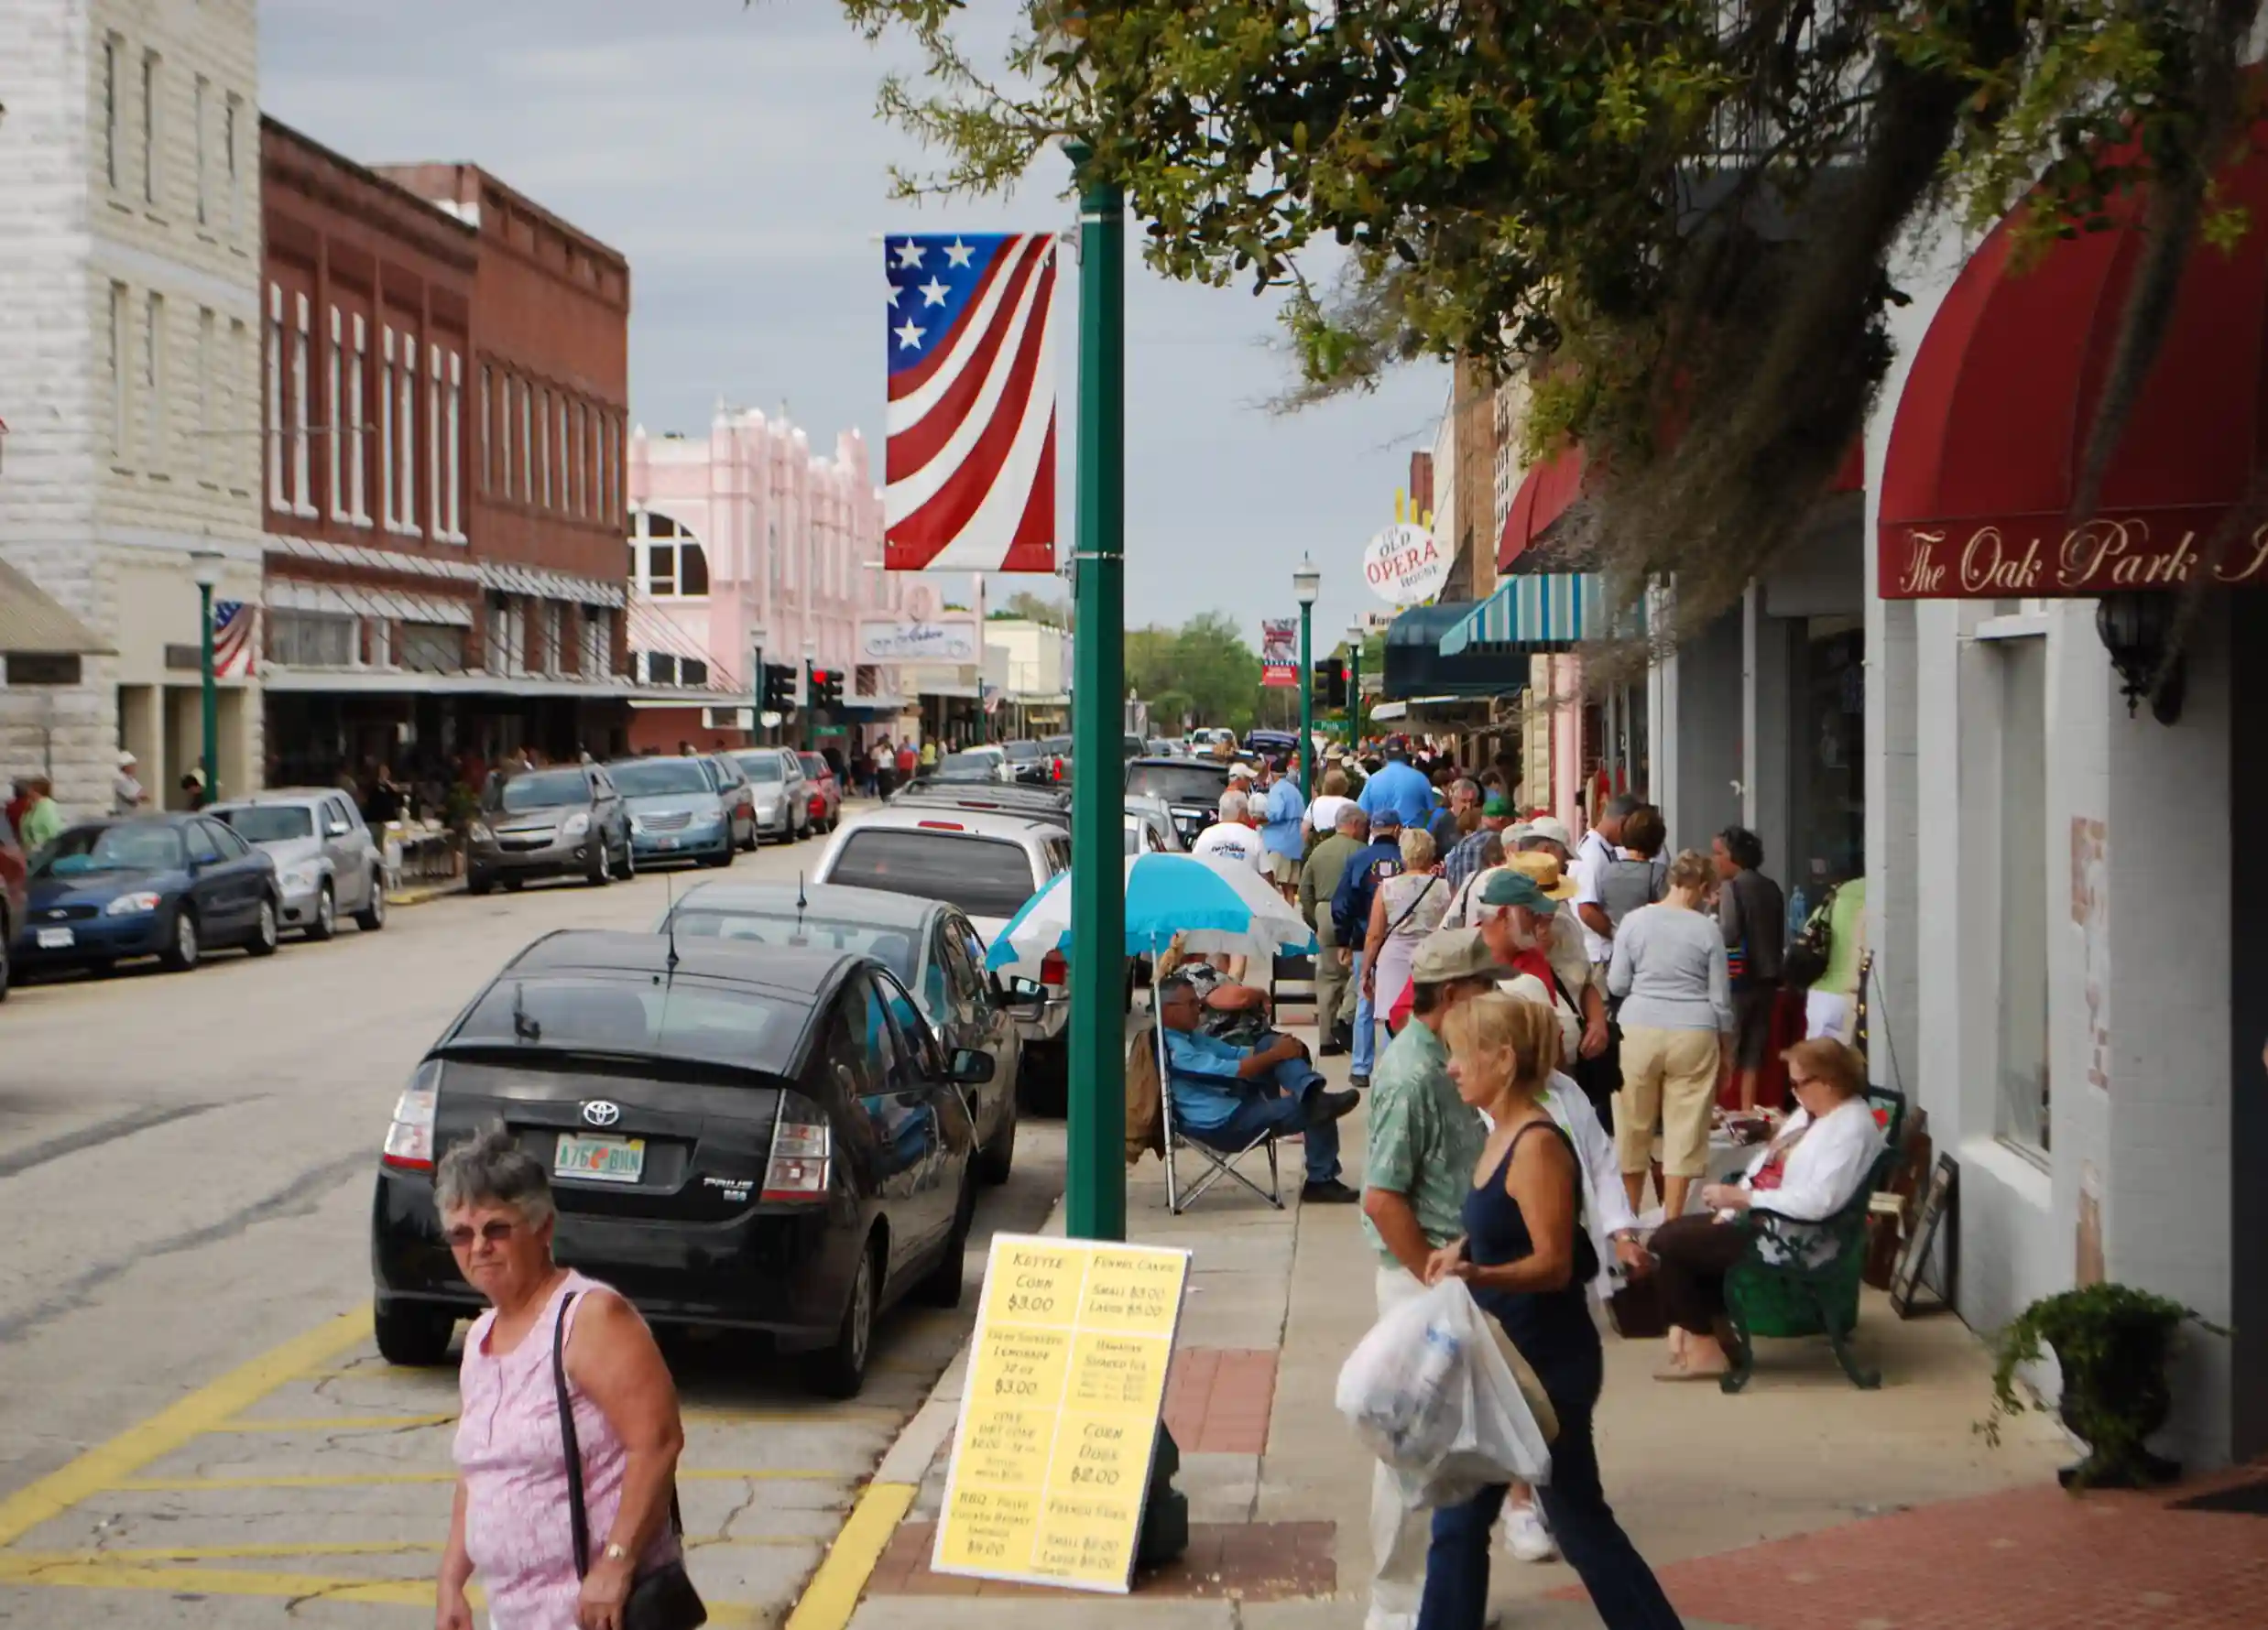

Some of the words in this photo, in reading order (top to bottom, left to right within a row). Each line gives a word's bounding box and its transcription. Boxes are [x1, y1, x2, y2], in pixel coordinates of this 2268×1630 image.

[1379, 532, 1411, 557] OLD
[1367, 538, 1439, 584] OPERA
[1899, 528, 1946, 593] The
[1961, 526, 2044, 592] Oak
[2057, 518, 2197, 588] Park
[1013, 1252, 1066, 1269] KETTLE
[1016, 1274, 1053, 1291] CORN
[1009, 1293, 1054, 1313] $3.00
[1084, 1423, 1124, 1440] CORN
